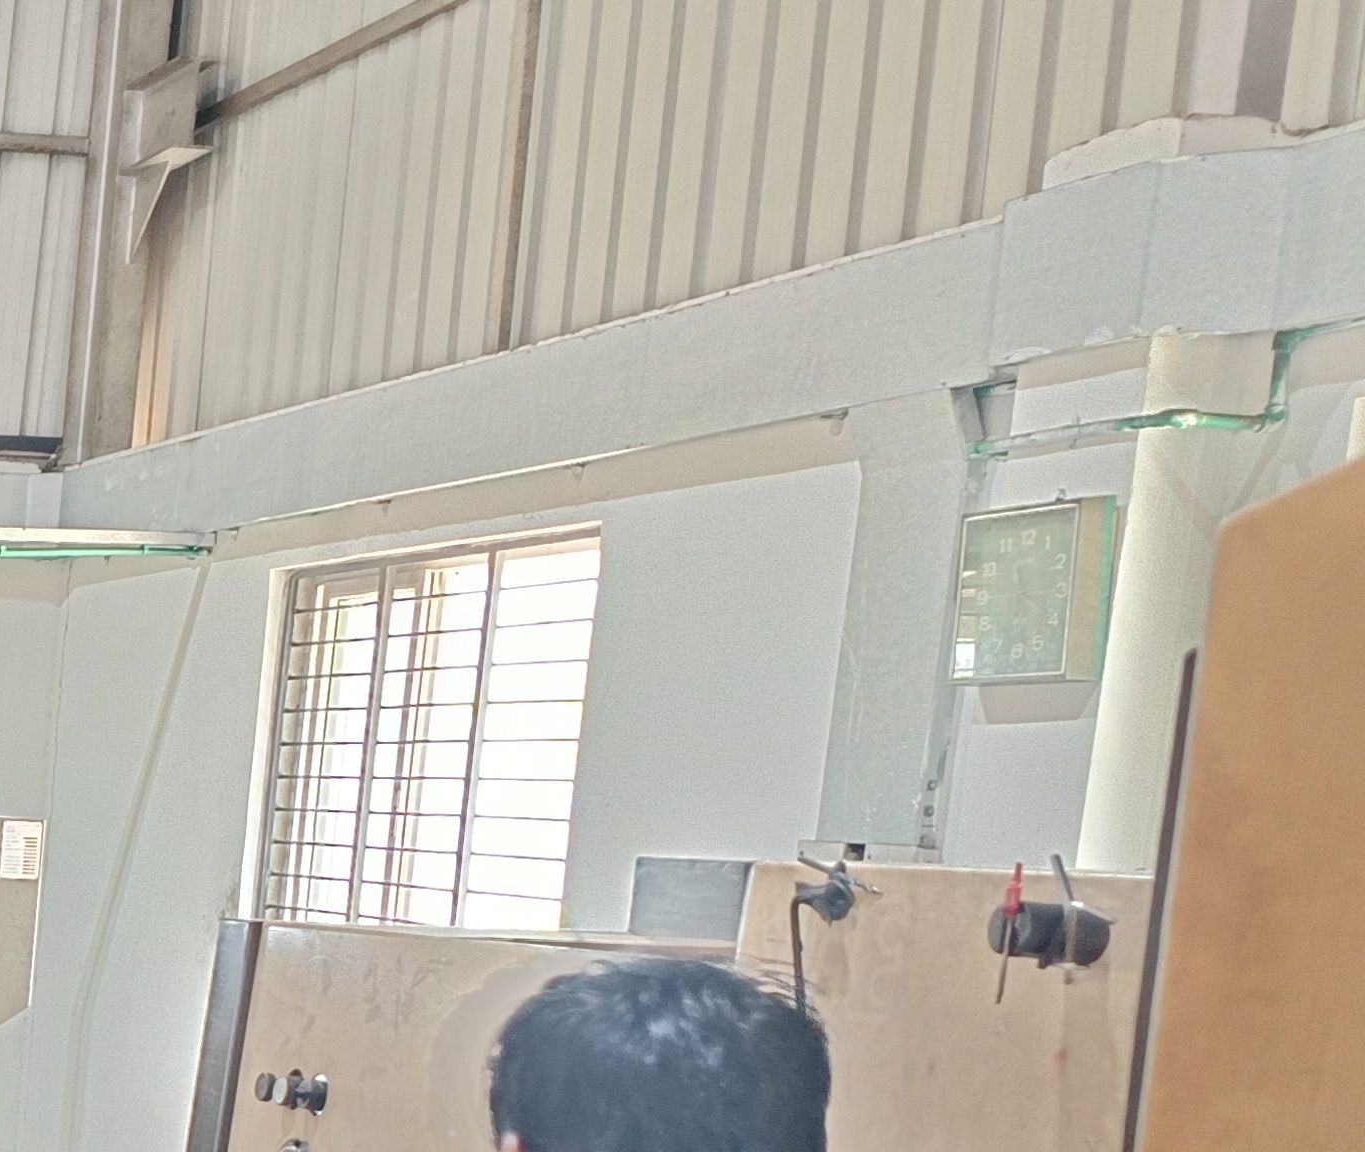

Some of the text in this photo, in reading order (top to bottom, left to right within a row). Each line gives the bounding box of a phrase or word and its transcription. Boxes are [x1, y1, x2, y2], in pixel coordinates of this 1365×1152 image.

[1021, 529, 1037, 546] 12
[1000, 538, 1013, 553] 11
[1056, 553, 1066, 569] 2
[982, 562, 996, 577] 10
[977, 590, 988, 605] 9
[1056, 582, 1068, 598] 3
[979, 616, 990, 631] 8
[1011, 643, 1024, 658] 6
[1032, 635, 1044, 651] 5
